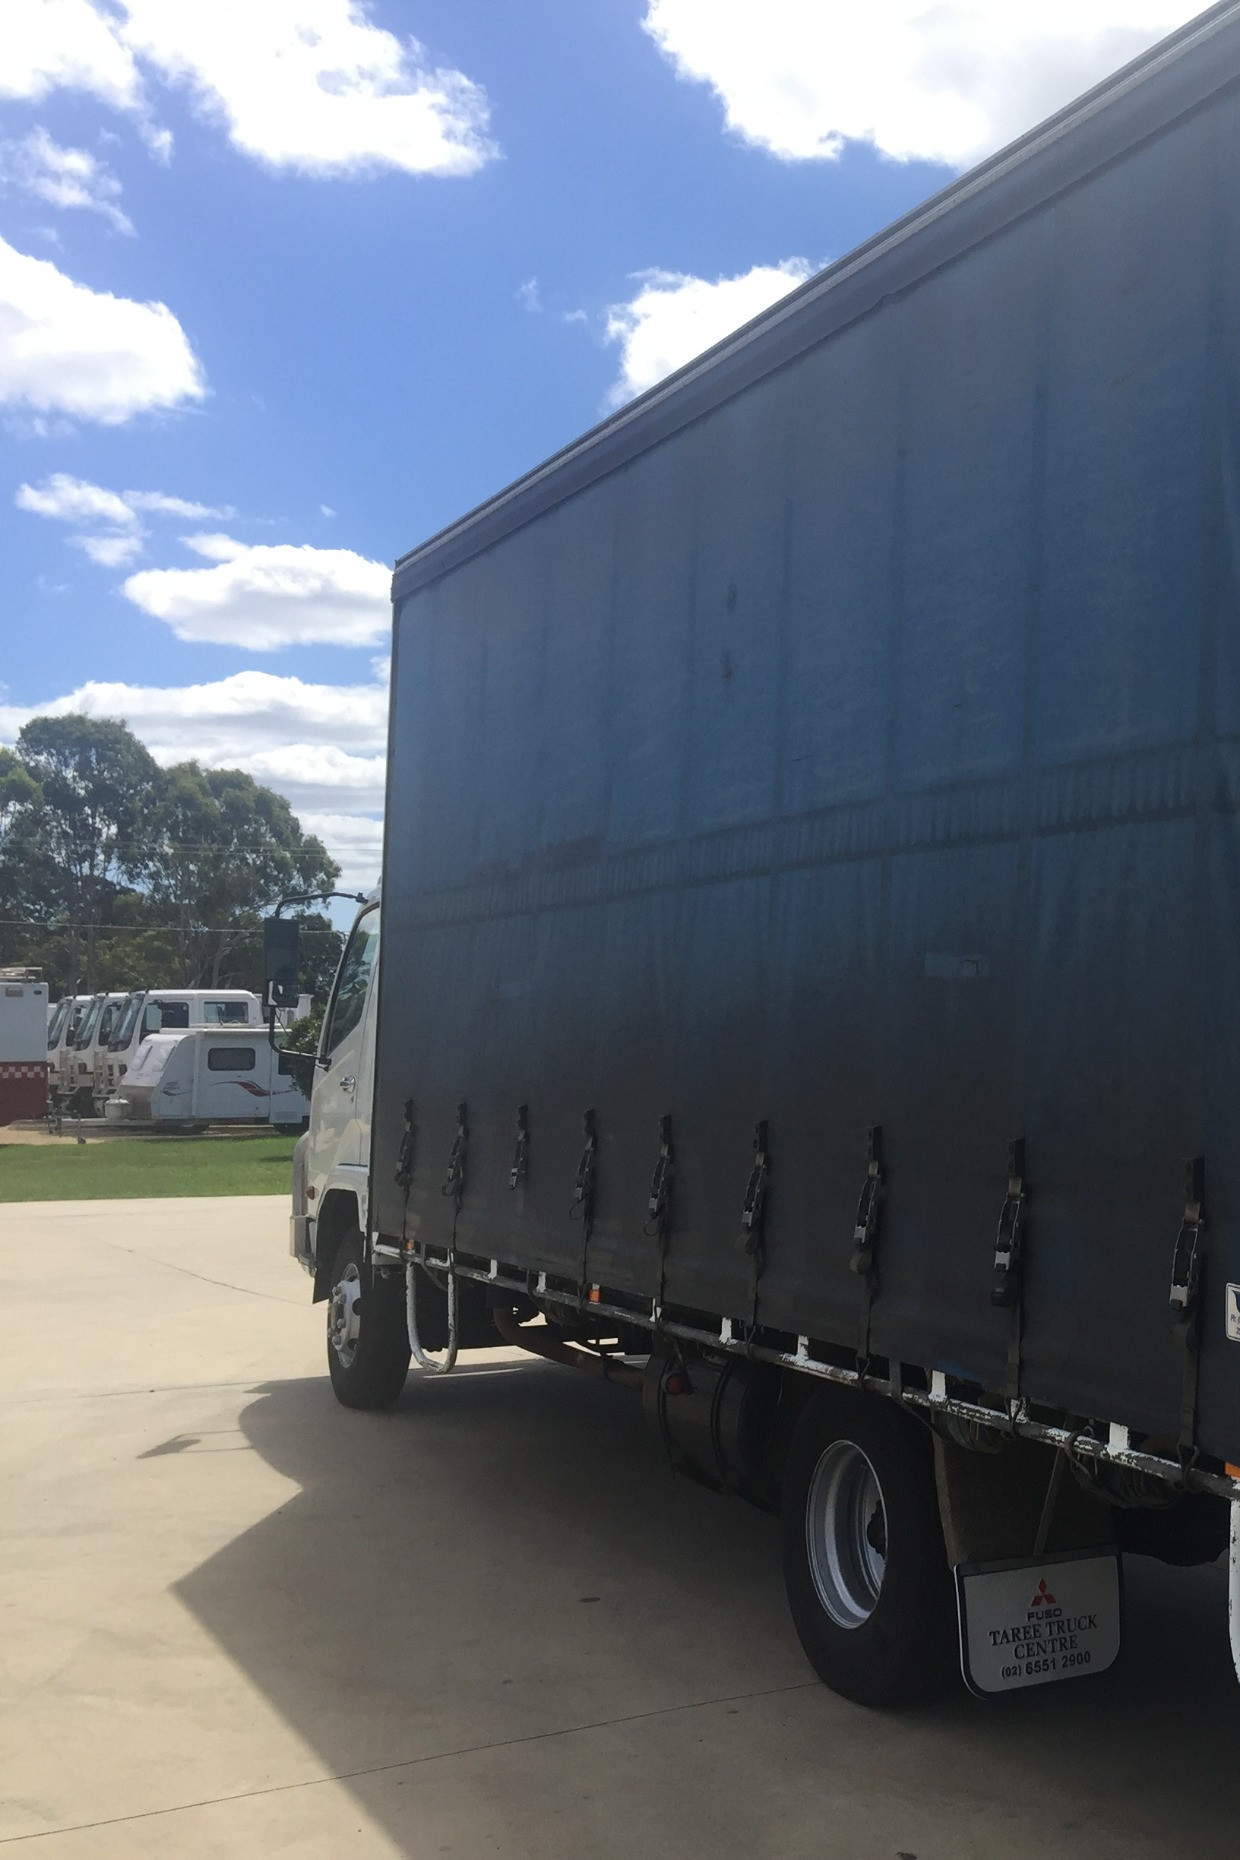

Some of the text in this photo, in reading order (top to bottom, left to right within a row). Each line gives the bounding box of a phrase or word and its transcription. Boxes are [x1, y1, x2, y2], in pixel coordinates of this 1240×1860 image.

[1027, 1608, 1062, 1622] FUSO
[989, 1614, 1098, 1646] TAREE TRUCK
[1014, 1634, 1078, 1660] CENTRE
[1001, 1651, 1091, 1678] (02) 6551 2900
